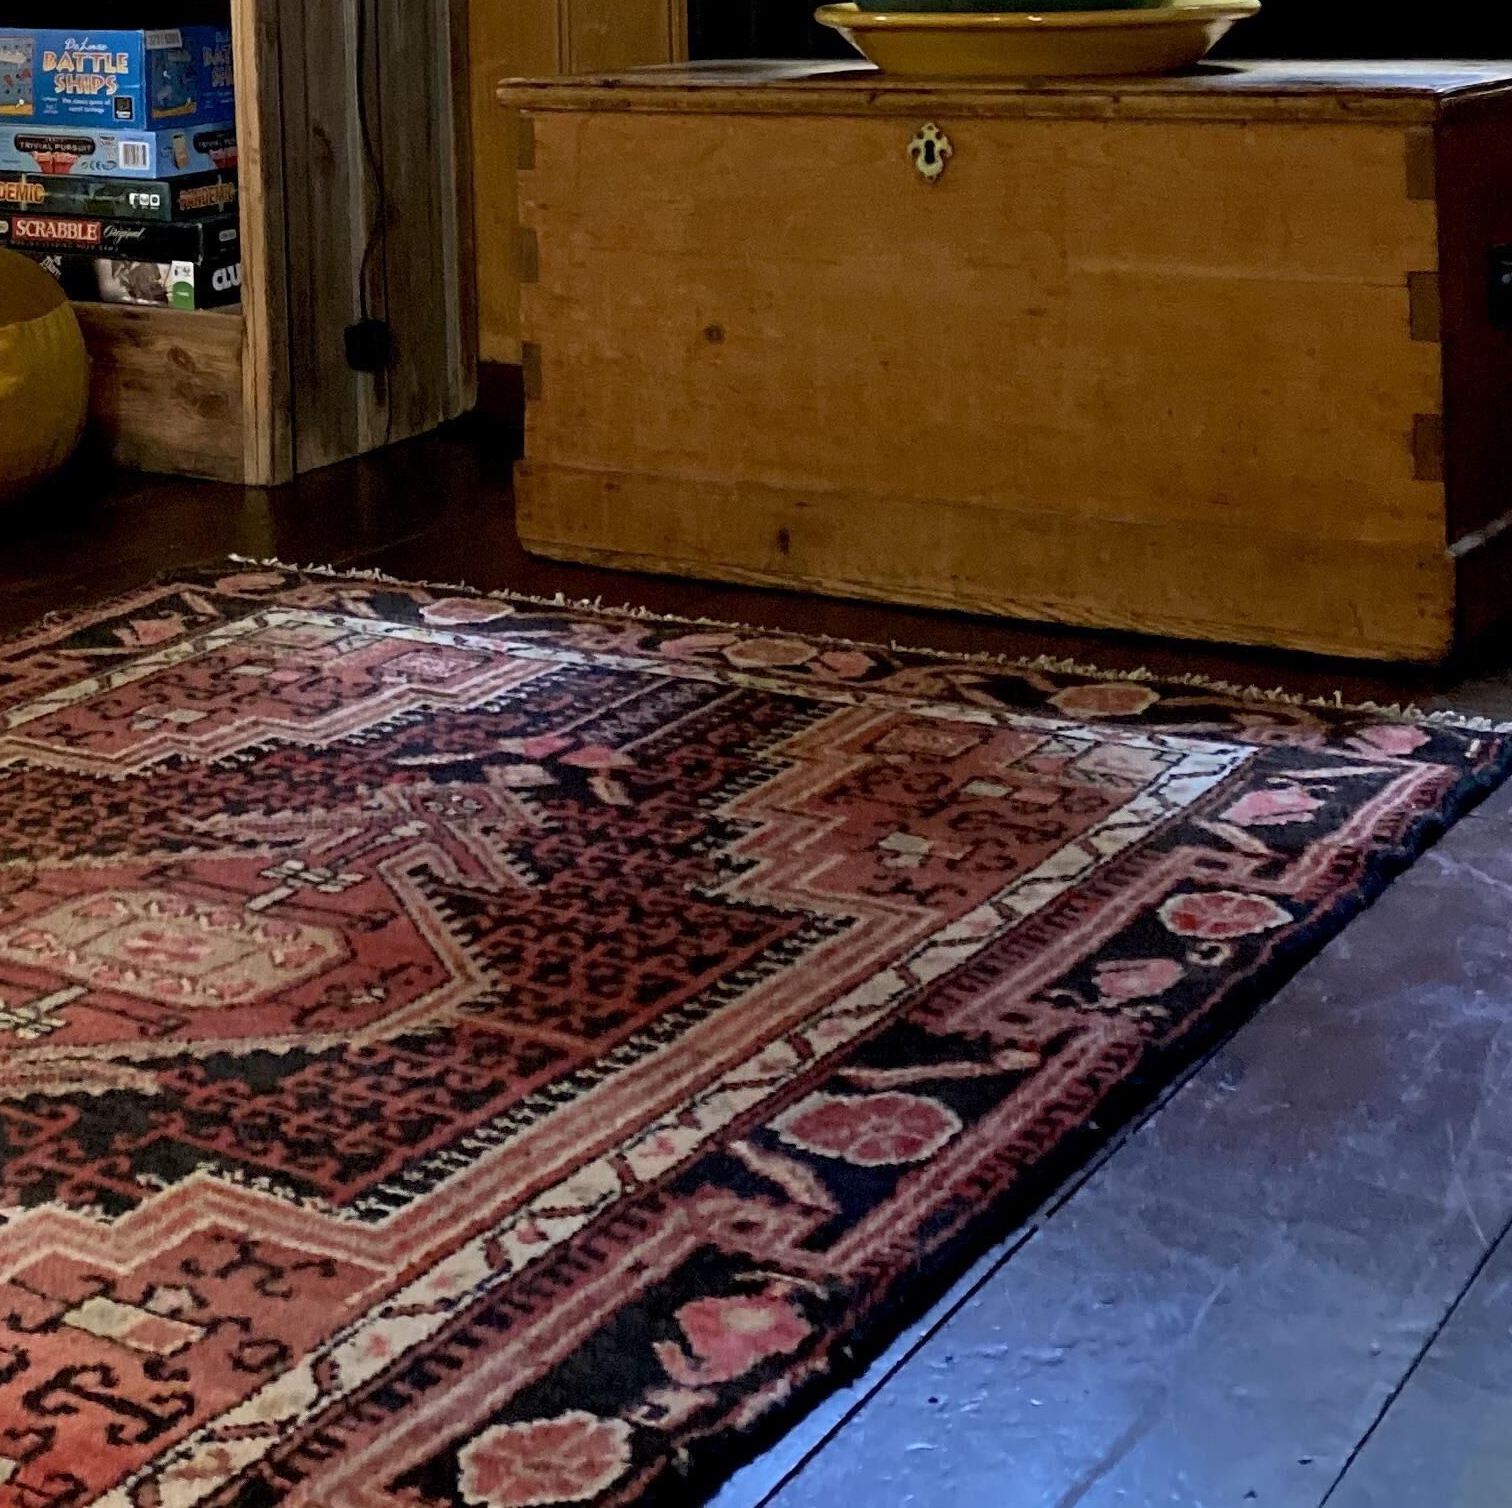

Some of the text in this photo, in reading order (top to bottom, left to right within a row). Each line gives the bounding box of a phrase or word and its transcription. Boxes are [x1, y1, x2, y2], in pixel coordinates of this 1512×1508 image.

[42, 50, 129, 75] BATTLE
[54, 73, 119, 96] SHIPS
[179, 181, 235, 210] PANDEMIC
[15, 219, 99, 241] SCRABBLE
[103, 224, 144, 244] Original
